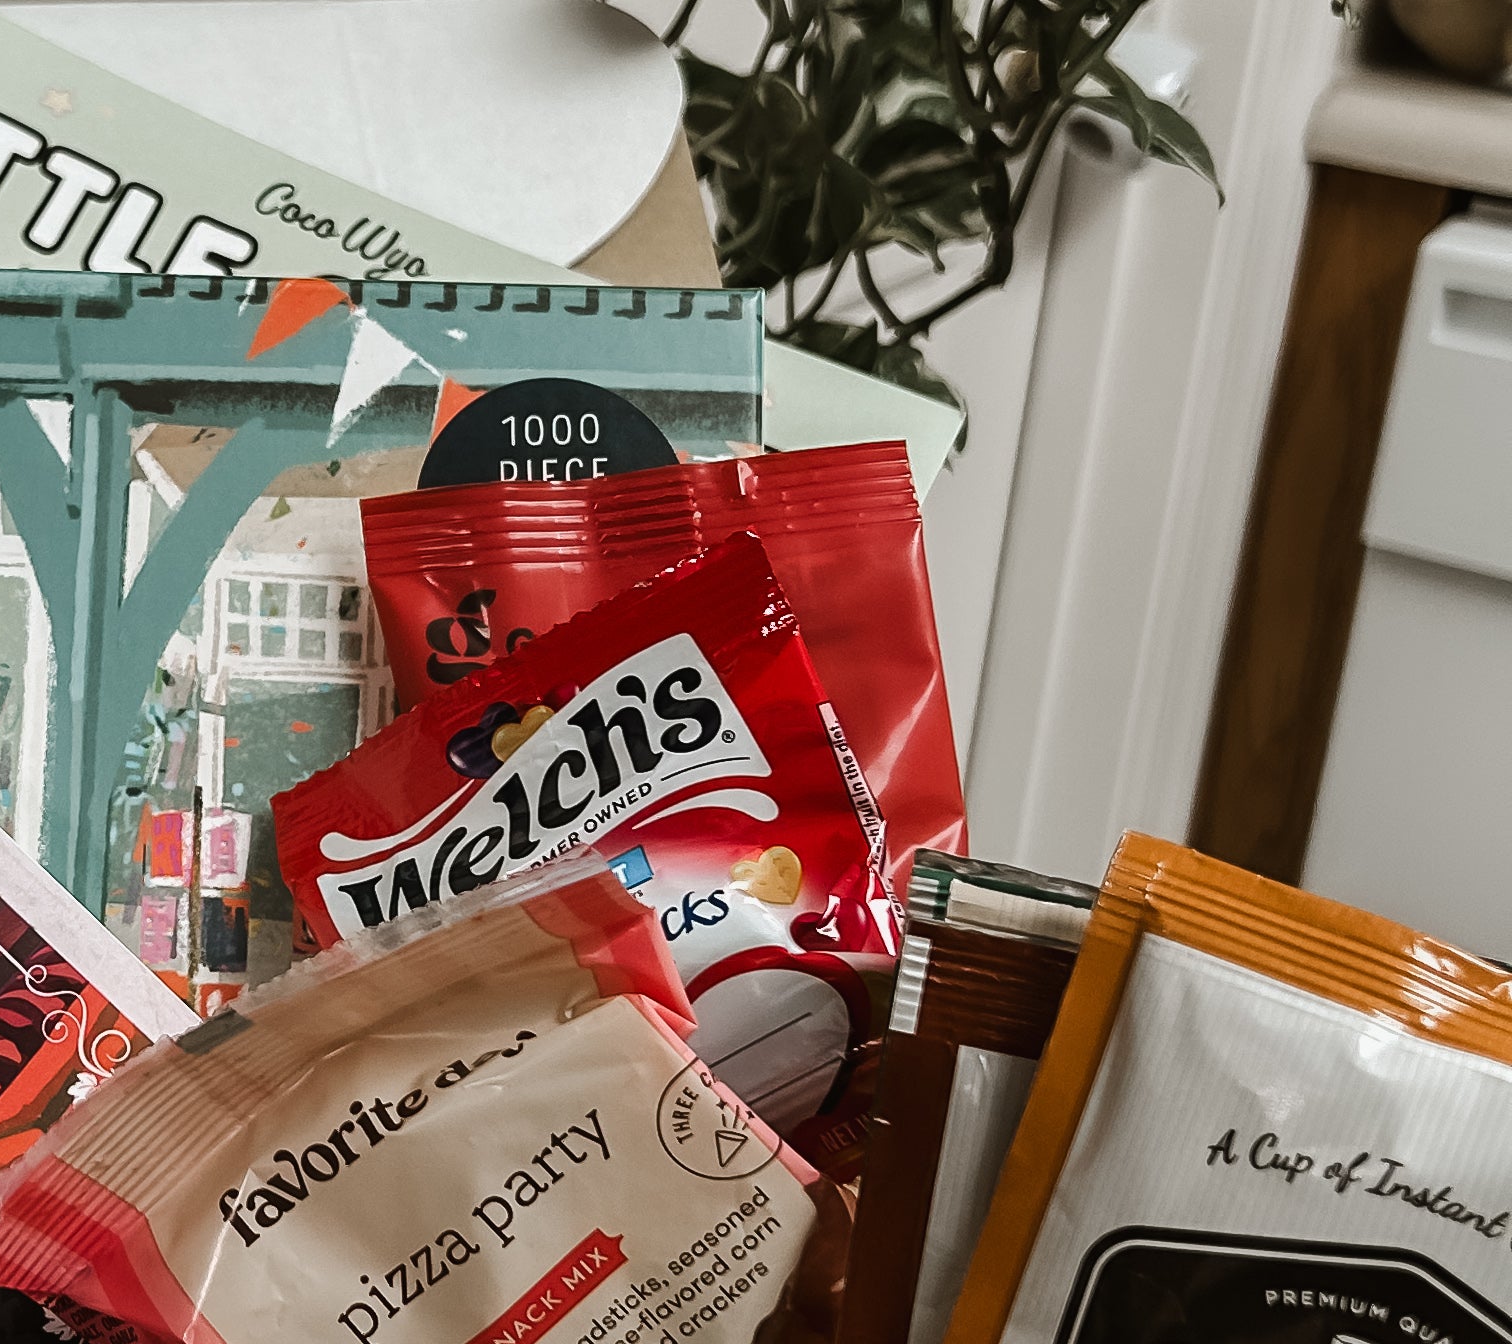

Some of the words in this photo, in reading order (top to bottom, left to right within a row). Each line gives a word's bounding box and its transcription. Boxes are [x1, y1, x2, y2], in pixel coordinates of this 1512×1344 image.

[255, 182, 340, 238] Coco
[341, 217, 431, 280] Wyo
[501, 413, 600, 447] 1000
[500, 457, 608, 482] PIECE
[843, 755, 859, 781] the
[852, 781, 865, 797] in
[338, 667, 722, 928] Welch's
[583, 782, 652, 833] OWNED
[672, 1087, 699, 1145] THREE
[218, 1088, 429, 1248] favorite
[472, 1108, 610, 1248] party
[1207, 1129, 1238, 1165] A
[1248, 1133, 1314, 1184] Cup
[1322, 1152, 1370, 1193] of
[1365, 1158, 1510, 1238] Instant
[667, 1185, 770, 1276] seasoned
[731, 1216, 782, 1262] corn
[560, 1246, 609, 1292] MIX
[679, 1260, 769, 1336] crackers
[1265, 1290, 1389, 1323] PREMIUM
